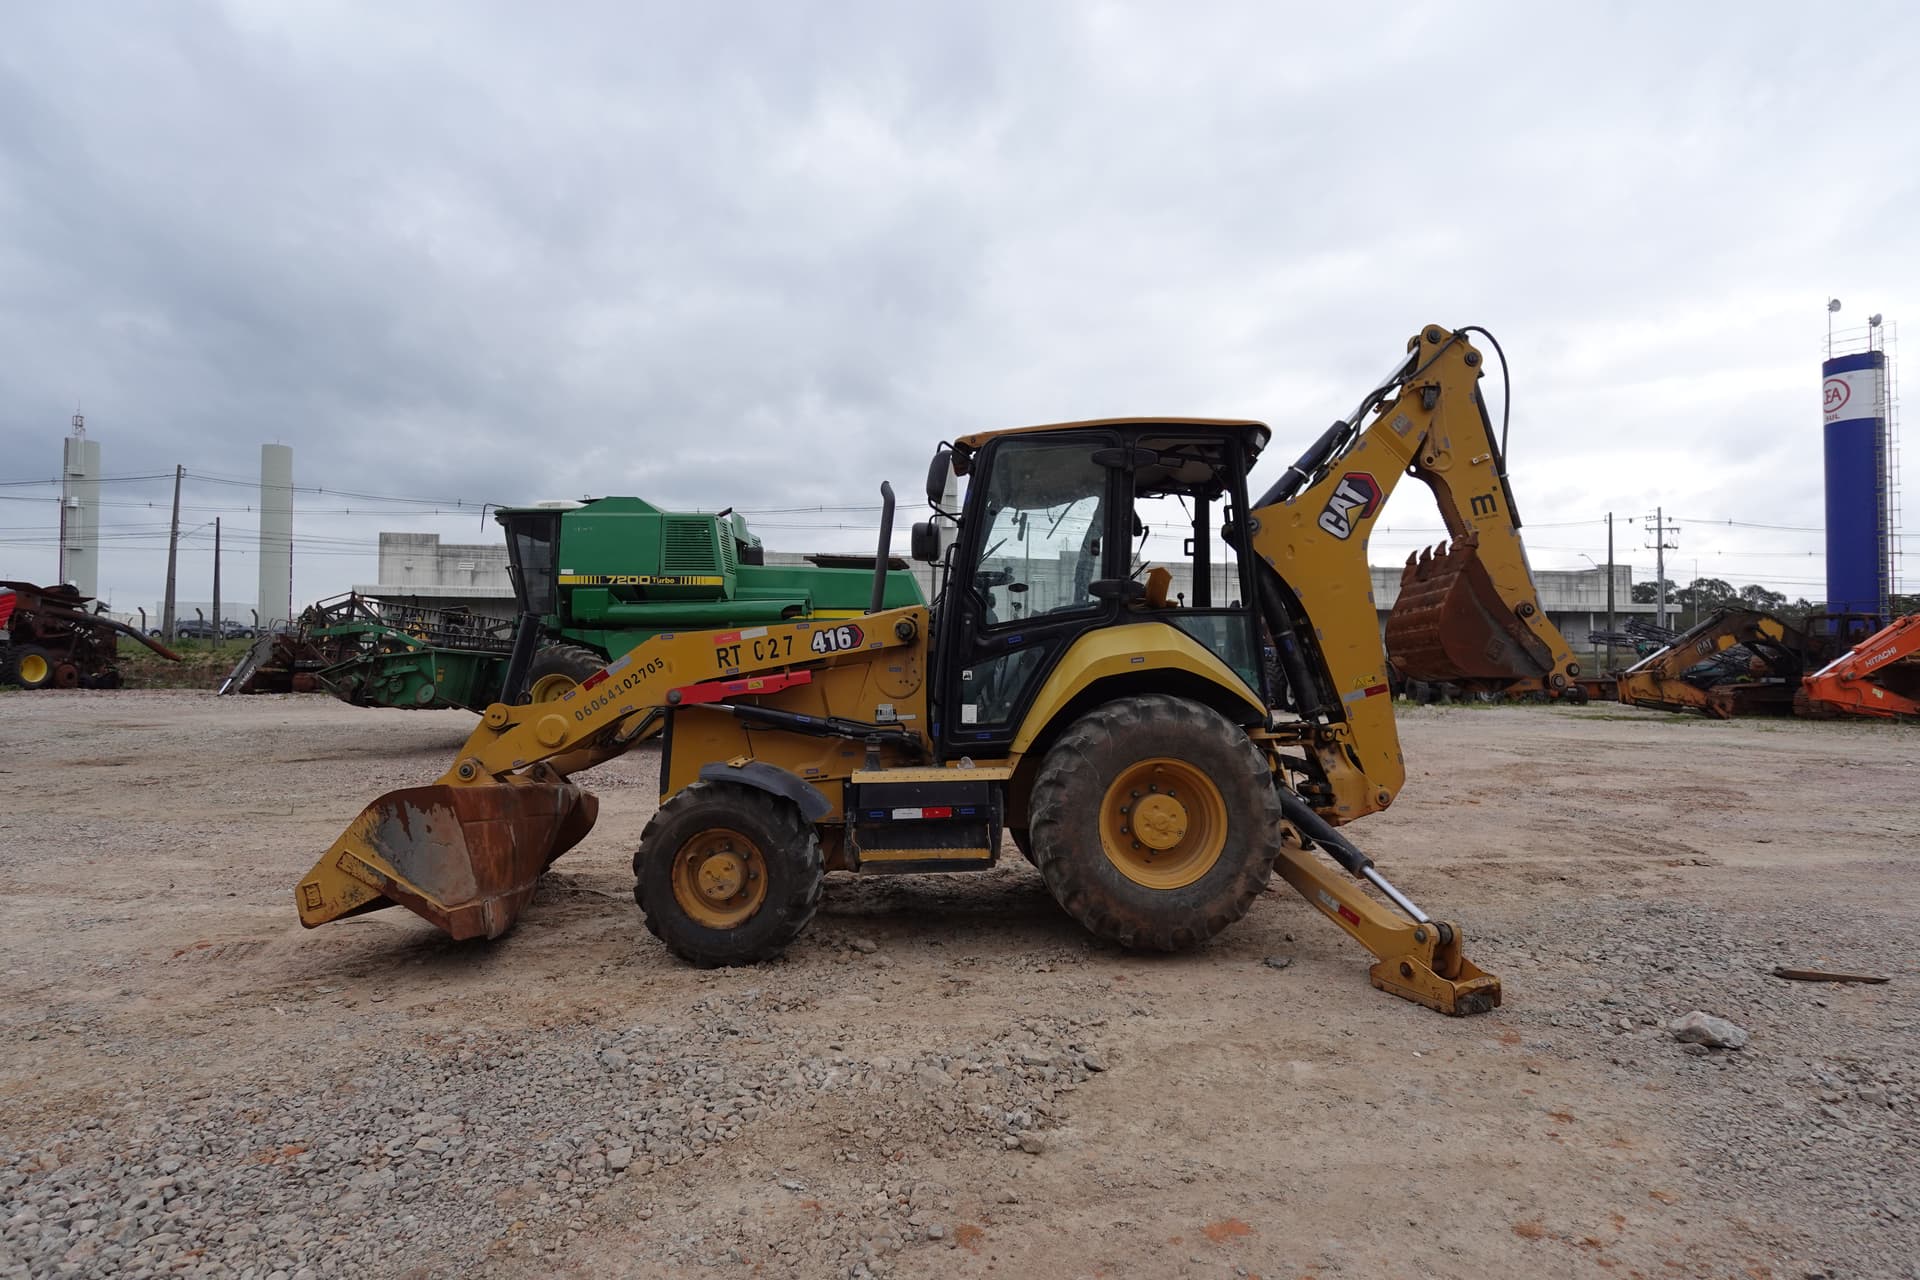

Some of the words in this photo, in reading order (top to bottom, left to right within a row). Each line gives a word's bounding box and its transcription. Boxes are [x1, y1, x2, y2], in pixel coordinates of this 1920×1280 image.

[1319, 479, 1369, 539] CAT
[606, 575, 651, 585] 7200
[652, 576, 675, 584] Turbo
[812, 626, 852, 653] 416
[1696, 637, 1712, 656] CAT
[716, 644, 741, 669] RT
[1864, 646, 1897, 668] HITACHI
[575, 656, 664, 721] 06064102705
